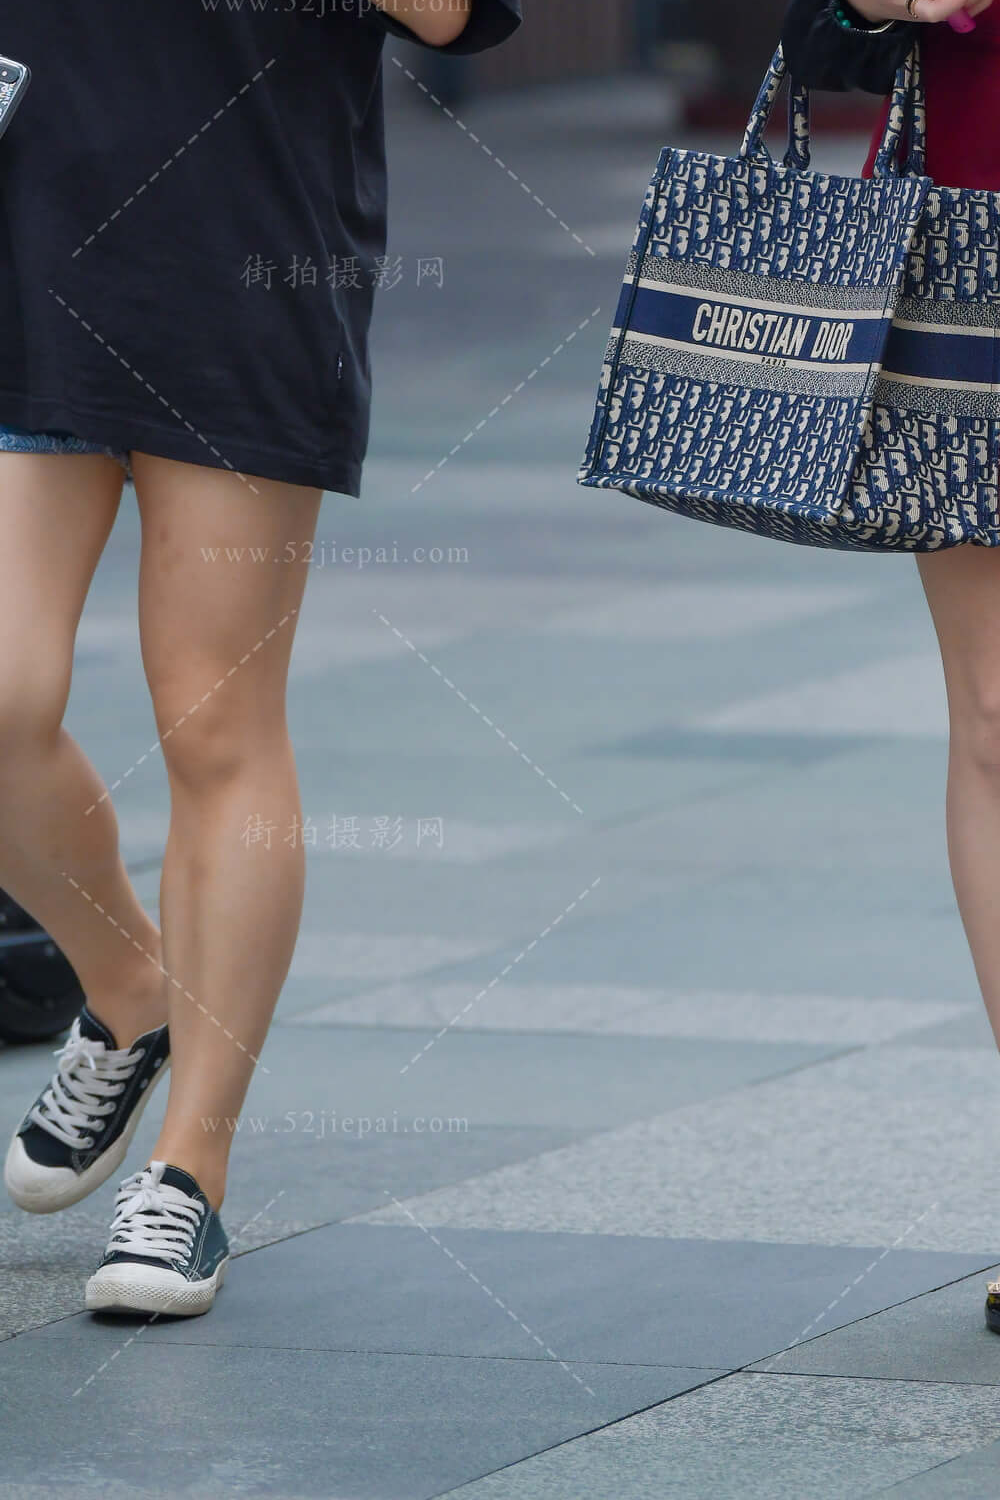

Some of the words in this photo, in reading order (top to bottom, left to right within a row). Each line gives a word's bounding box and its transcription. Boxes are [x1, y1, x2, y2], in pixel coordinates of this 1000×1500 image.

[692, 303, 811, 357] CHRISTIAN
[810, 321, 854, 360] DIOR
[761, 356, 787, 367] PARIS
